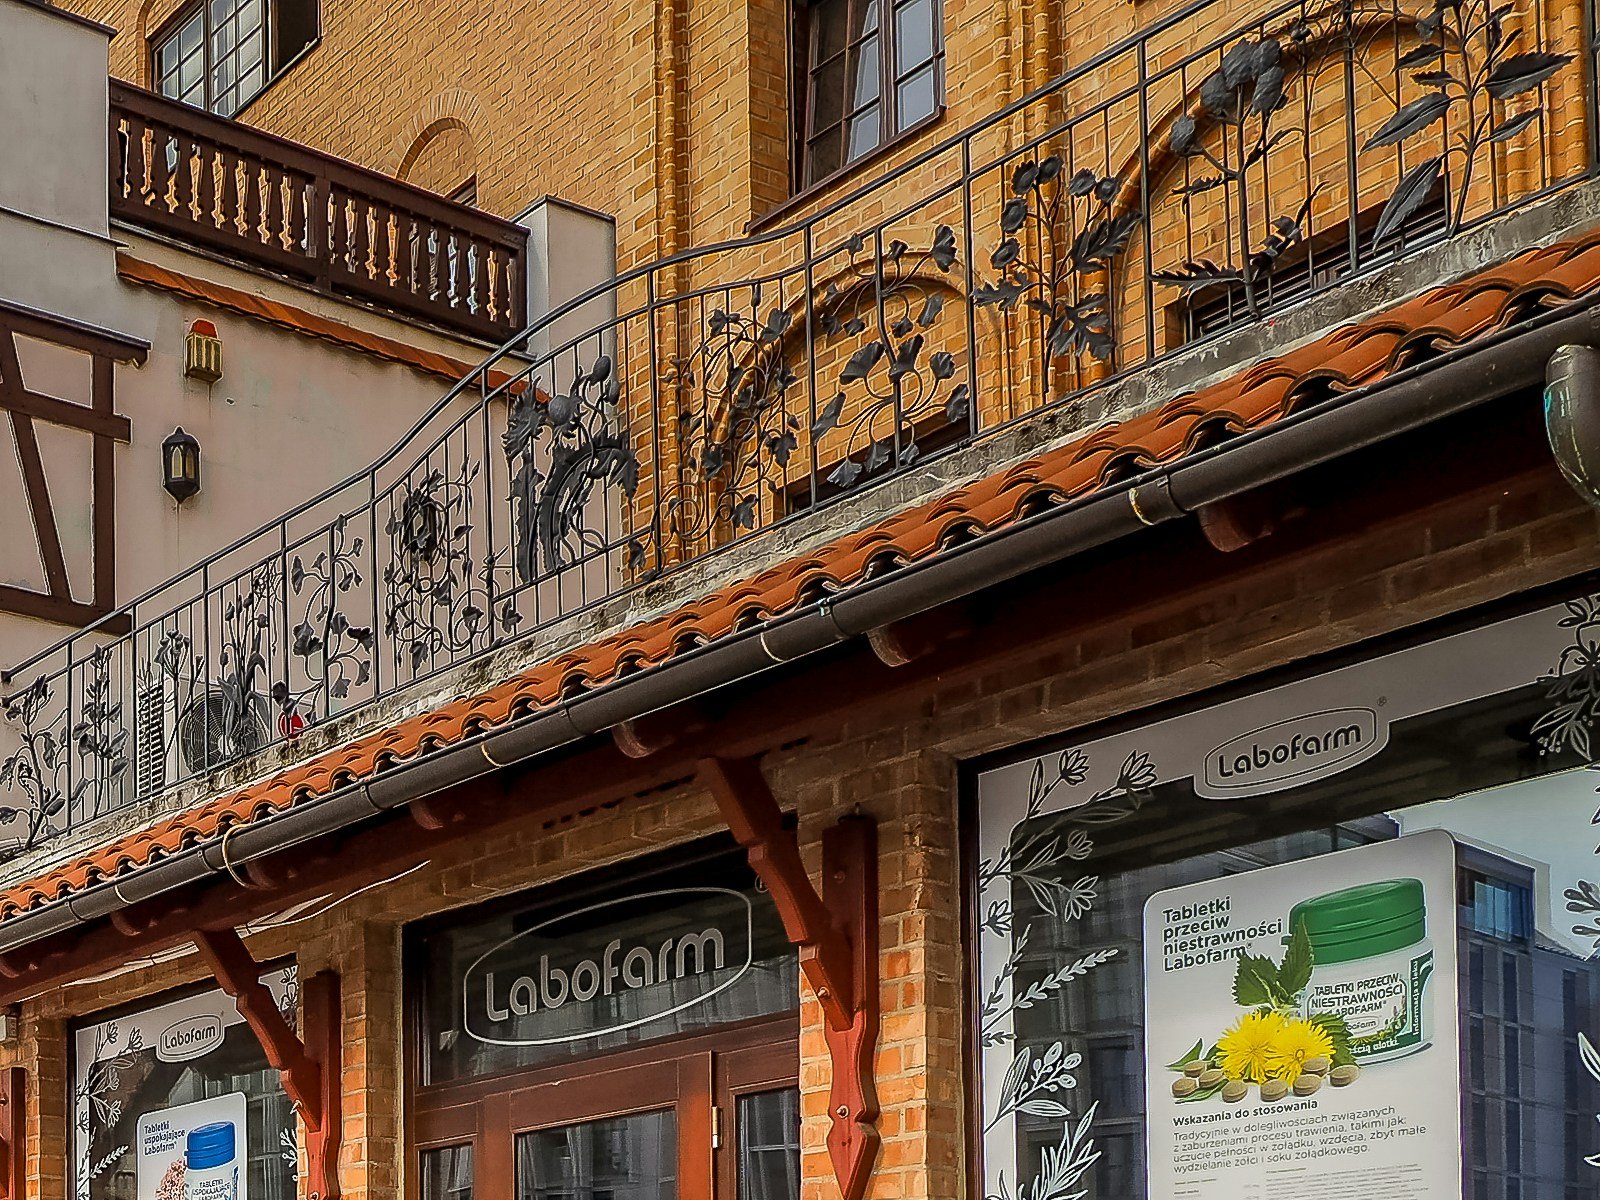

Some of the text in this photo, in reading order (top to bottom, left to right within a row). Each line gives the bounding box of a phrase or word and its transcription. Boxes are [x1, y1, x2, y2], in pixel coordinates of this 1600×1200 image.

[1218, 724, 1361, 777] Labofarm
[1163, 896, 1230, 923] Tabletki
[1163, 916, 1229, 942] przeciw
[1163, 918, 1282, 956] niestrawności
[486, 928, 724, 1022] Labofarm
[1314, 973, 1399, 997] TABLETKI PRZECIW
[1311, 985, 1402, 1008] NIESTRAWNOŚCI
[165, 1025, 216, 1049] Labofarm
[1173, 1100, 1318, 1127] Wskazania do stosowania
[1174, 1127, 1229, 1141] Tradycyjnie
[1331, 1106, 1395, 1122] związanych
[144, 1121, 170, 1135] Tabletki
[1182, 1137, 1248, 1152] zaburzeniami
[1251, 1131, 1292, 1145] procesu
[1351, 1119, 1385, 1131] takimi
[1174, 1151, 1211, 1162] uczucie
[1370, 1129, 1394, 1141] zbyt
[1173, 1159, 1232, 1174] wydzielanie
[1267, 1151, 1292, 1163] soku
